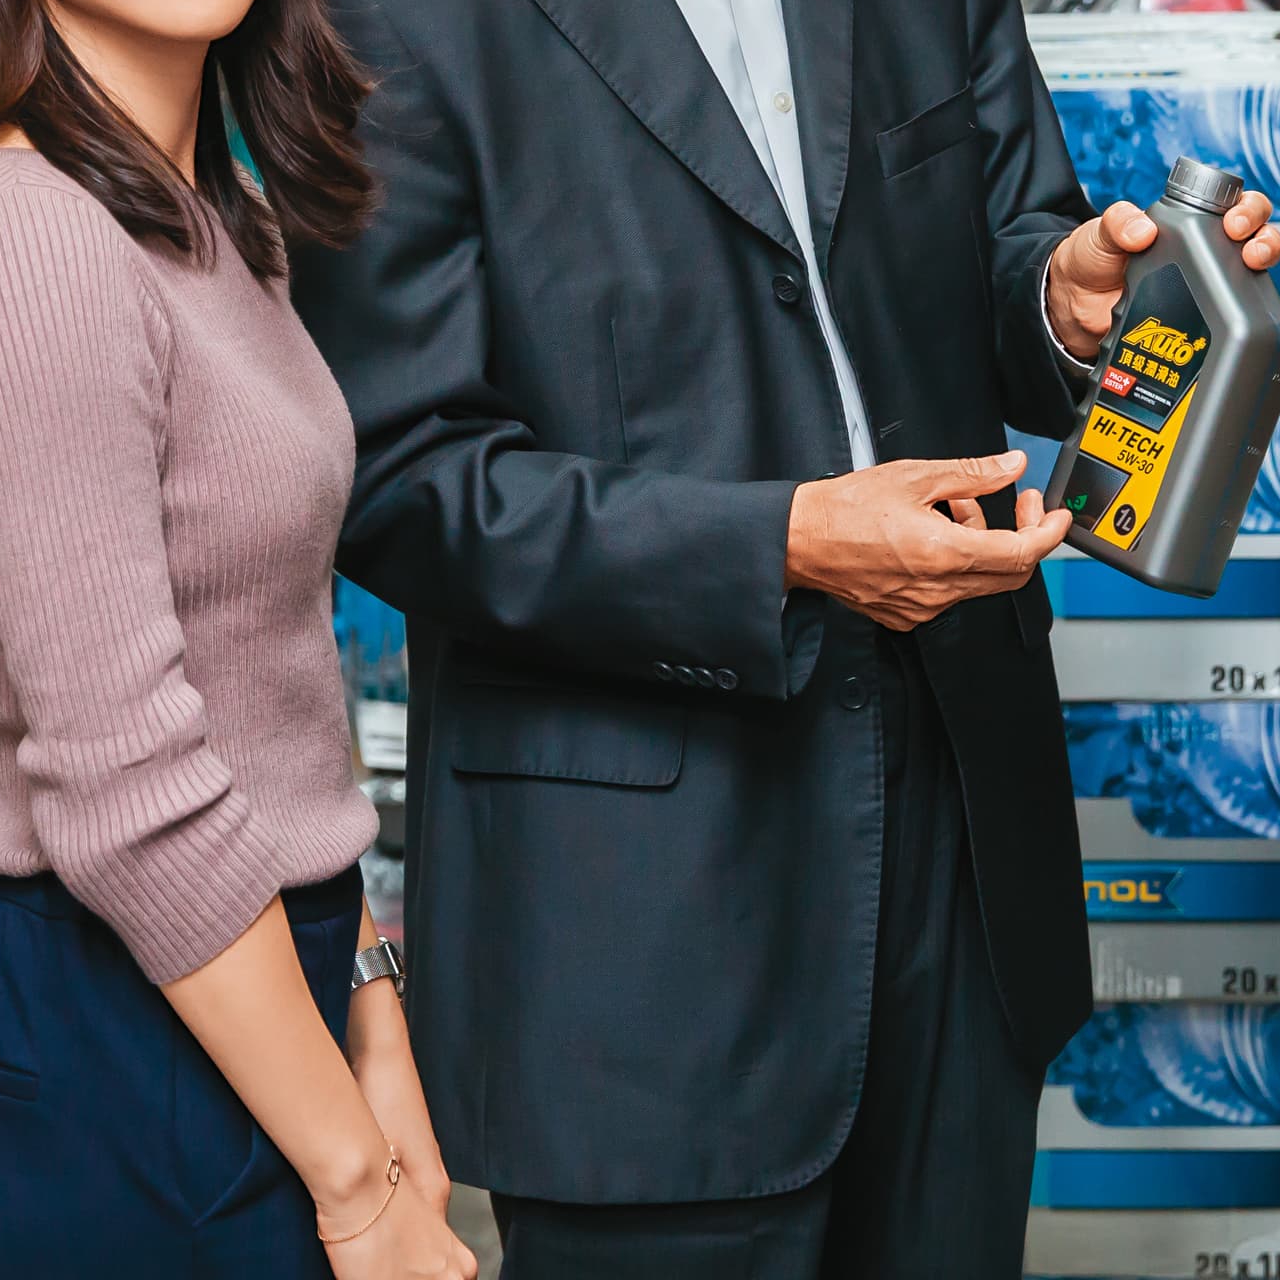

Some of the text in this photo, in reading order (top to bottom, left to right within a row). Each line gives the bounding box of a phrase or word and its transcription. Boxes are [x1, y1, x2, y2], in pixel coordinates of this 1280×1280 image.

[1092, 416, 1164, 460] HI-TECH
[1117, 449, 1154, 475] 5W-30
[1115, 508, 1133, 532] 1L
[1210, 665, 1245, 692] 20
[1083, 880, 1162, 902] NOL
[1222, 966, 1257, 994] 20
